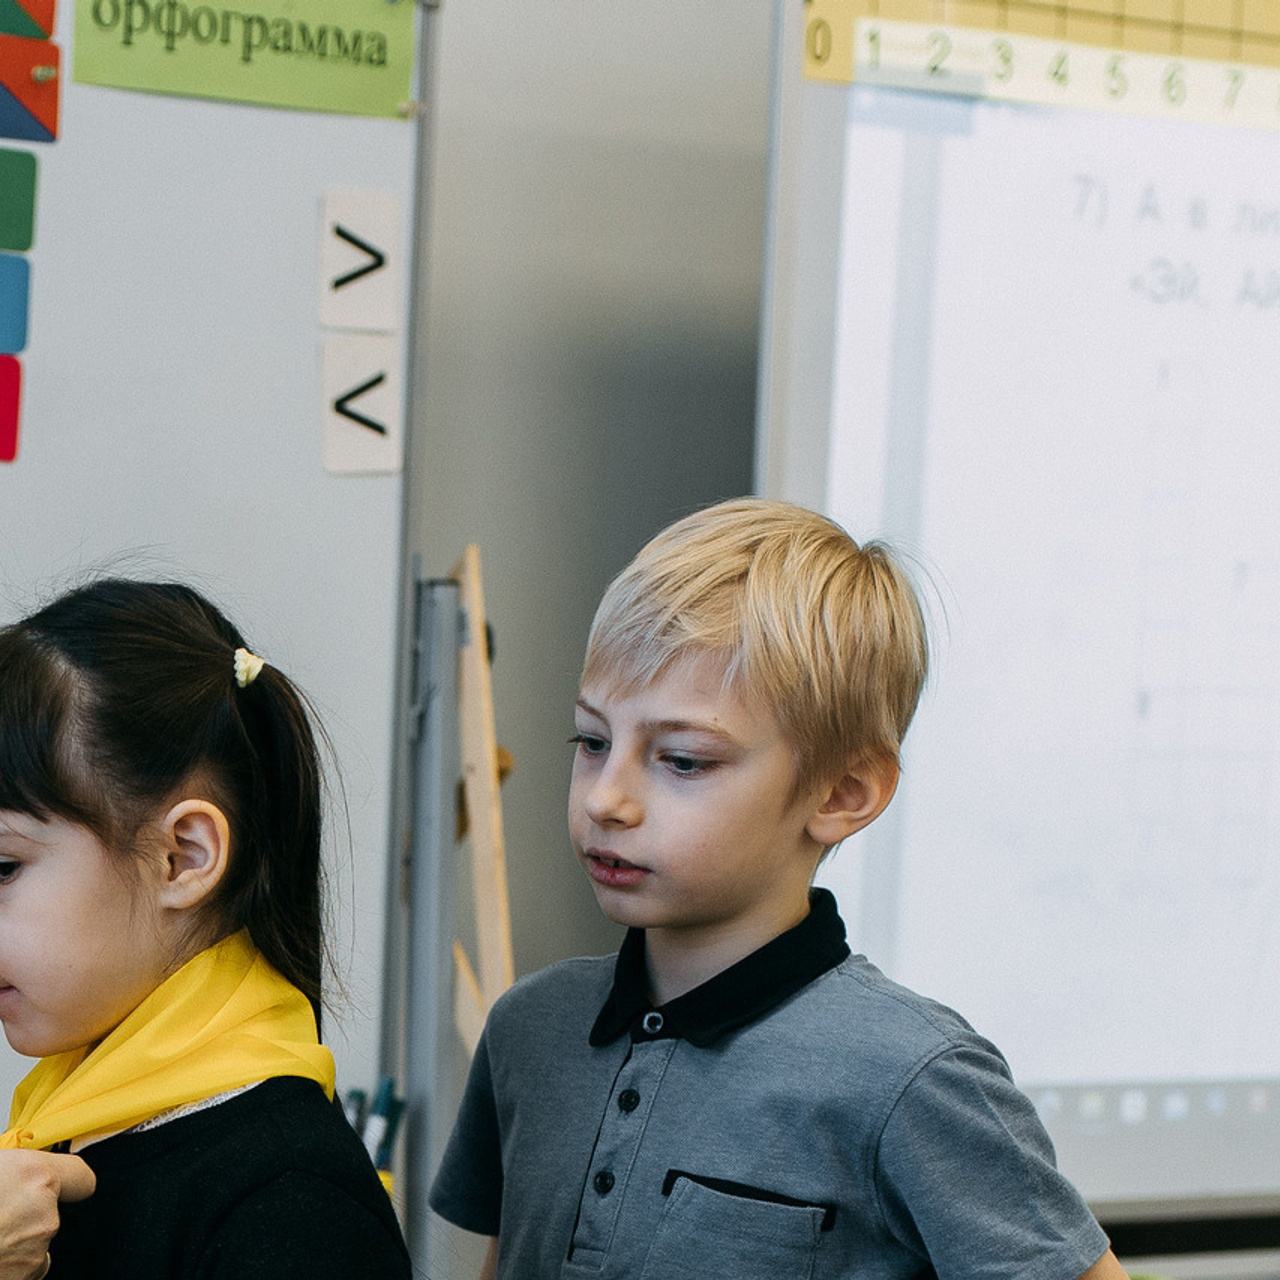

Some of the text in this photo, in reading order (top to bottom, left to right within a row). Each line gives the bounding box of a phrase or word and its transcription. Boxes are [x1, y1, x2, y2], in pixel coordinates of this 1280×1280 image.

[91, 0, 388, 64] орфограмма
[866, 26, 882, 71] 1
[926, 30, 953, 77] 2
[993, 38, 1015, 84] 3
[1048, 50, 1070, 88] 4
[1106, 54, 1128, 99] 5
[1161, 61, 1188, 107] 6
[1223, 67, 1246, 110] 7
